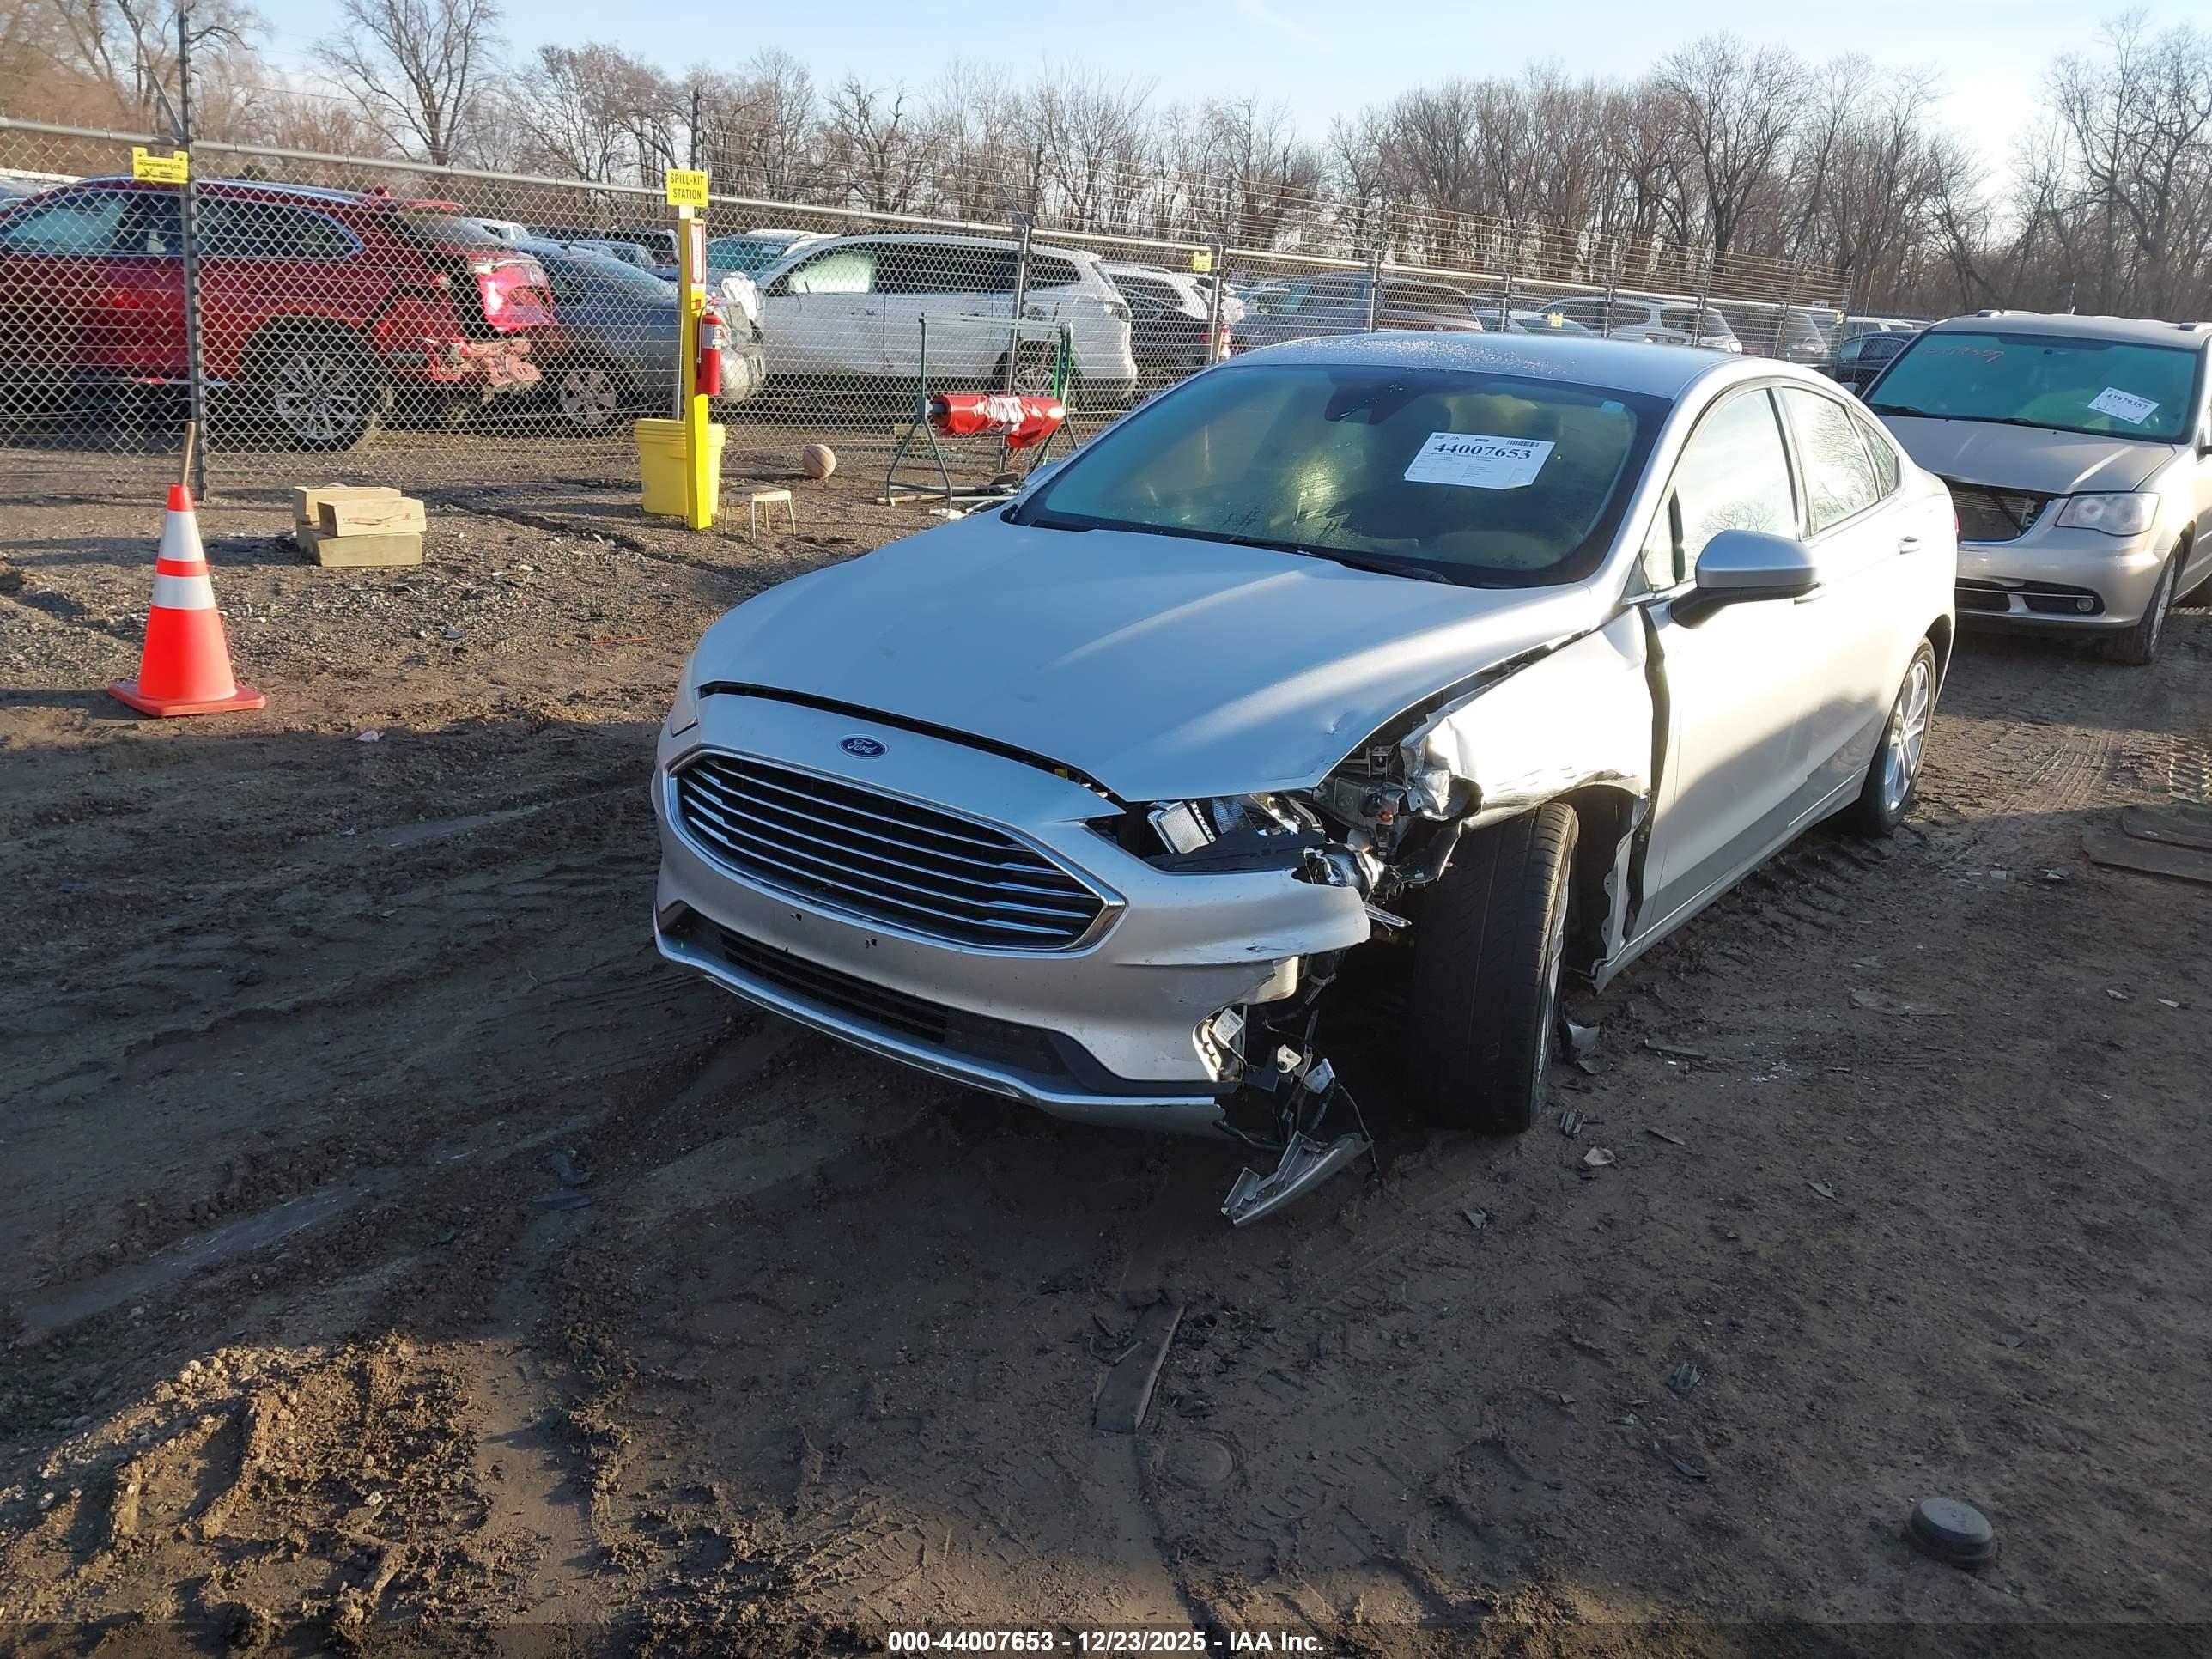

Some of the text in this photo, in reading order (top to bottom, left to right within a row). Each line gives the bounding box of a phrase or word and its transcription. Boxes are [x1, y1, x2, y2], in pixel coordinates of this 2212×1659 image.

[670, 173, 704, 186] SPILL-KIT
[672, 188, 702, 200] STATION
[1433, 442, 1532, 459] 44007653
[847, 738, 877, 754] Ford
